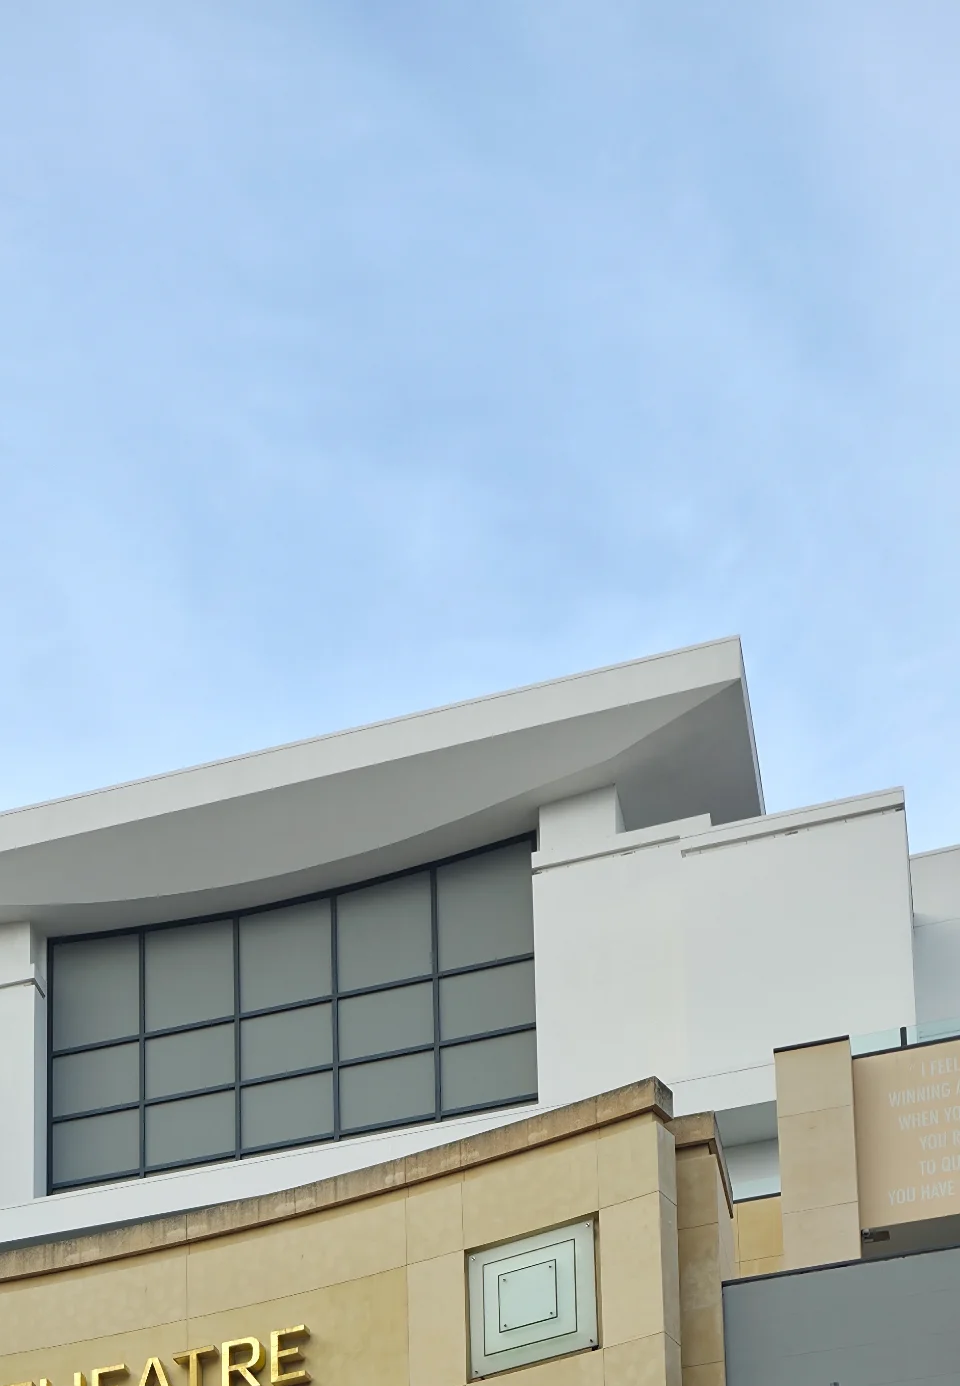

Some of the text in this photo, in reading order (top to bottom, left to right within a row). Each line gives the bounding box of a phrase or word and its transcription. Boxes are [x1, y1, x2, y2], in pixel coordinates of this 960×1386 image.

[888, 1081, 951, 1108] WINNING
[898, 1109, 939, 1131] WHEN
[919, 1131, 947, 1151] YOU
[918, 1159, 936, 1176] TO
[888, 1180, 956, 1206] YOU HAVE
